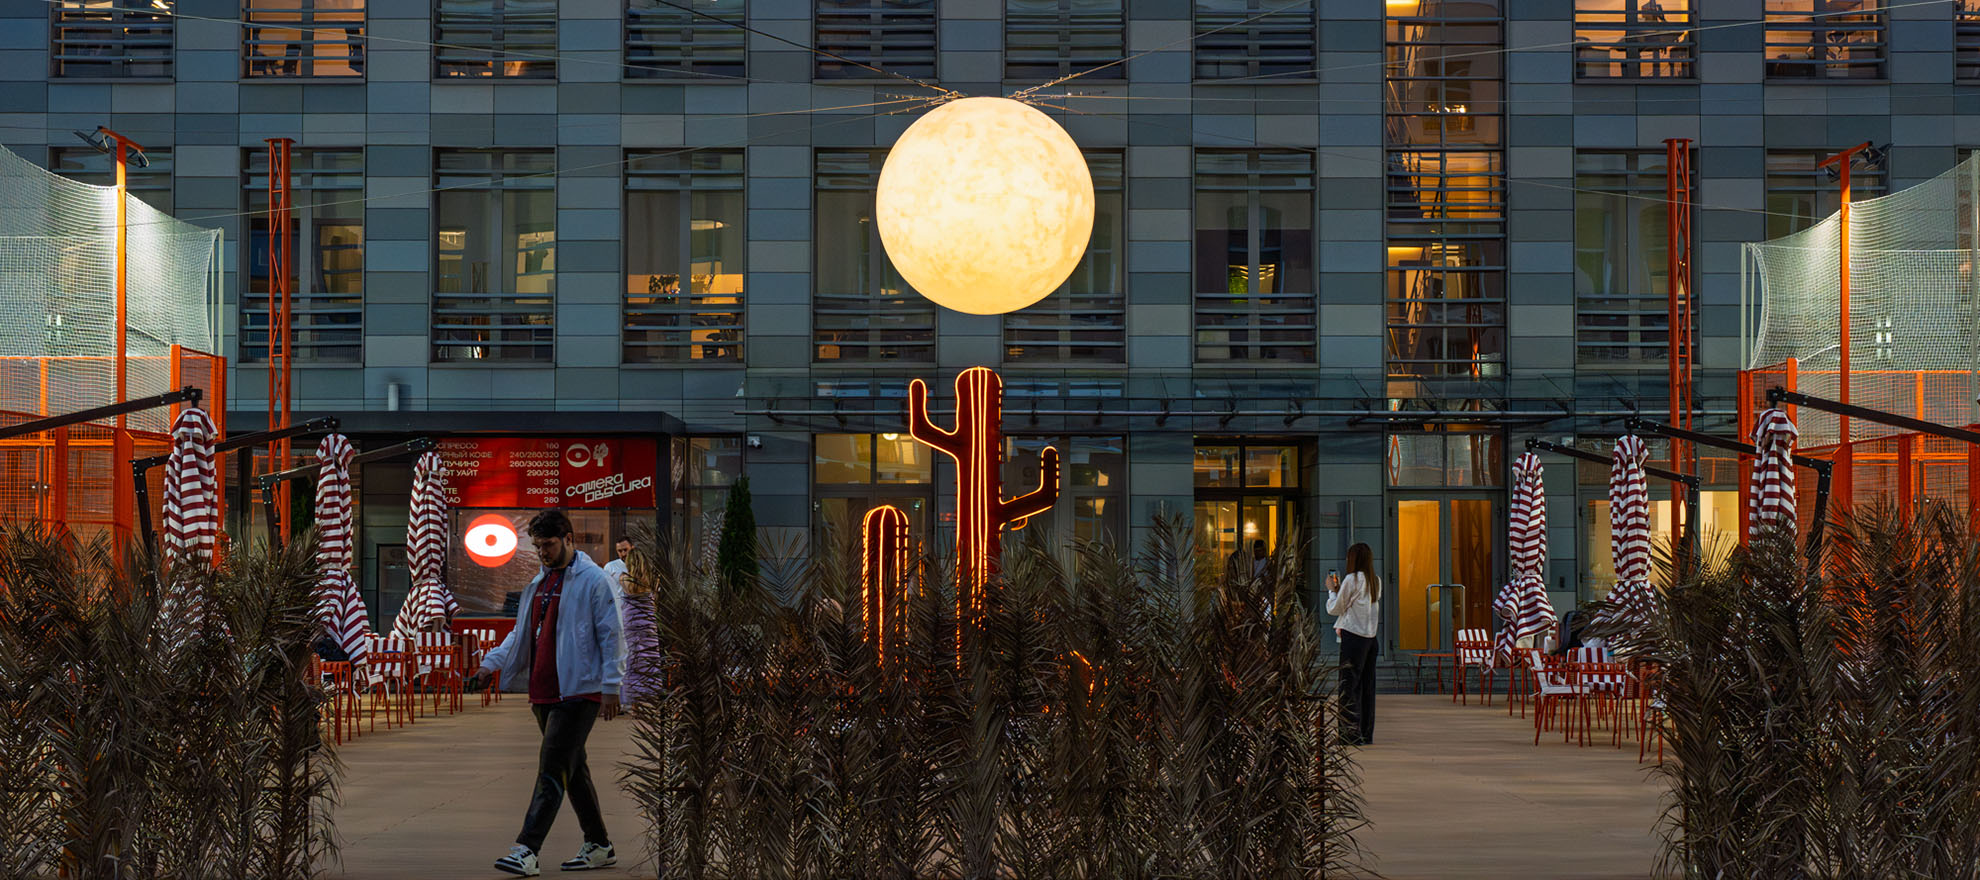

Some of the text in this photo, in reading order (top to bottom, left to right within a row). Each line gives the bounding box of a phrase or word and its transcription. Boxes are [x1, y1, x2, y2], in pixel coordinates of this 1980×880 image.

[439, 450, 468, 458] ЕРНЫЙ
[469, 451, 493, 459] КОФЕ
[443, 460, 480, 468] ПУЧИНО
[456, 468, 479, 477] УАЙТ
[543, 478, 560, 486] 350
[526, 487, 560, 495] 290/340
[543, 496, 560, 504] 280
